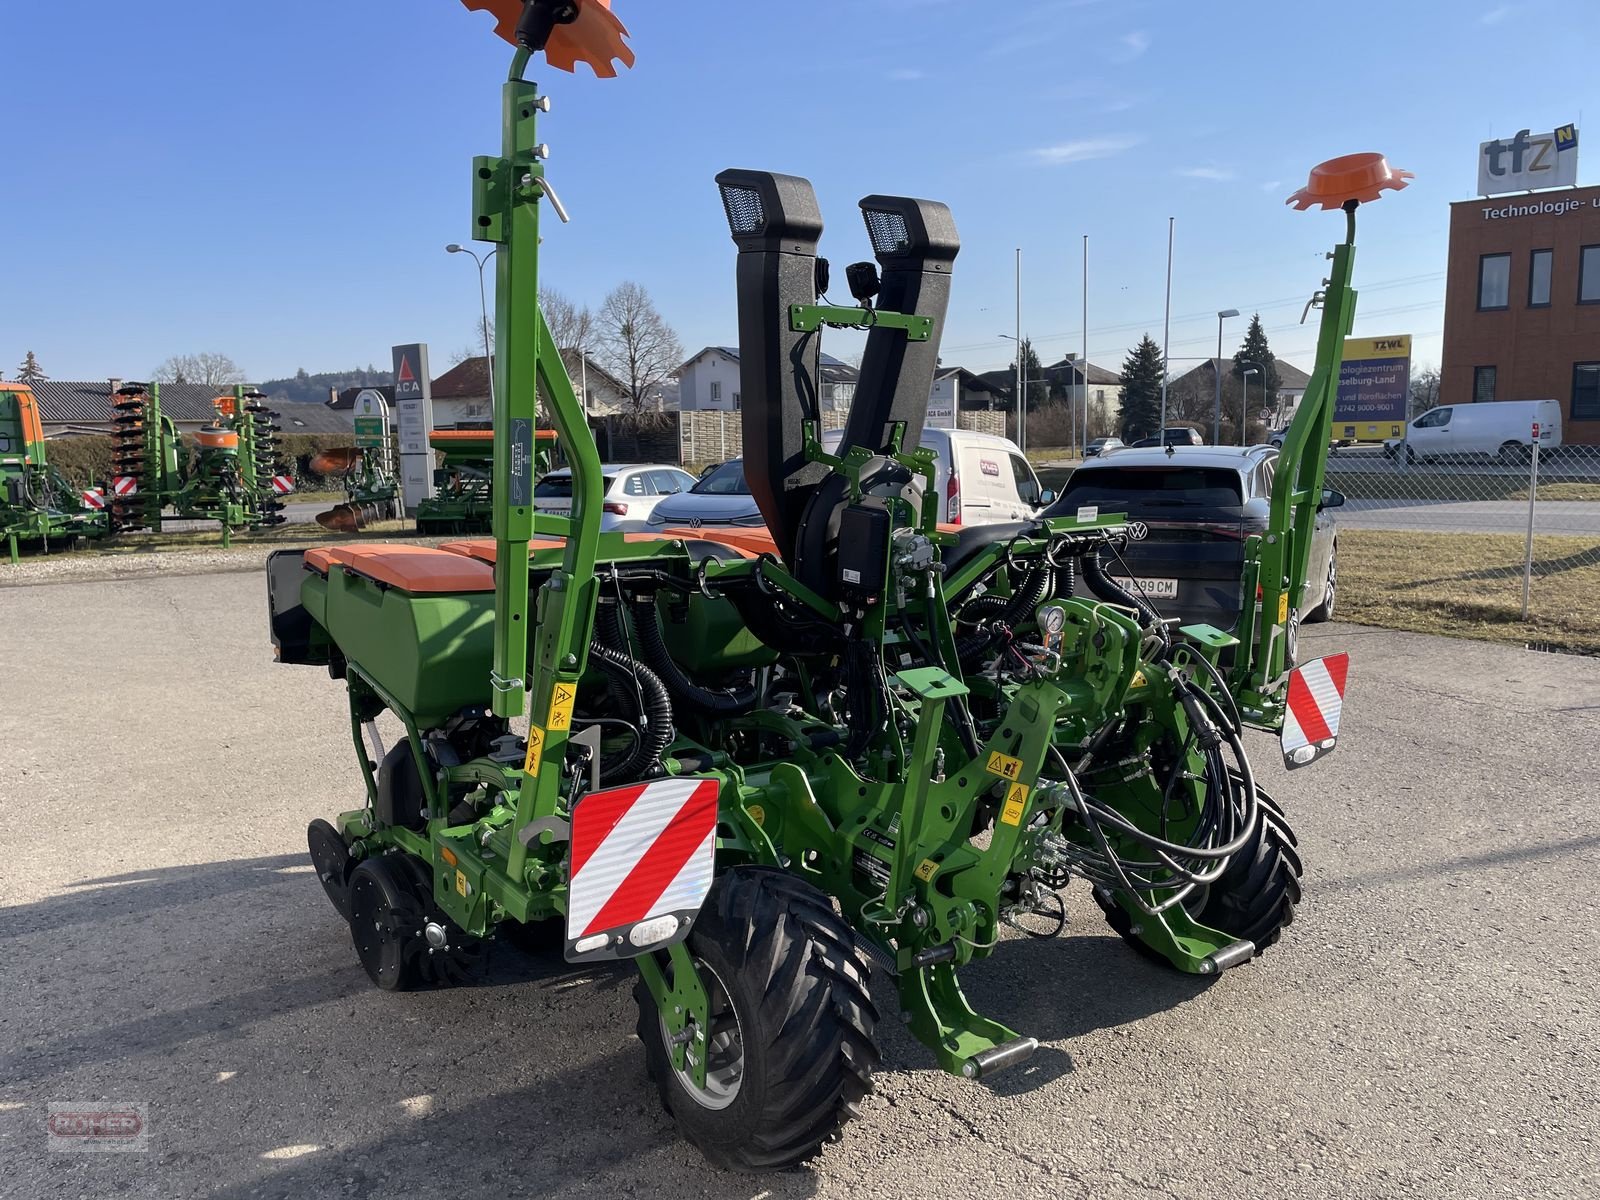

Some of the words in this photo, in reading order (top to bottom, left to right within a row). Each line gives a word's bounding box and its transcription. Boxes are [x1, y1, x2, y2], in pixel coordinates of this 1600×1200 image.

[1482, 199, 1585, 219] Technologie-
[1340, 364, 1404, 375] ologiezentrum
[396, 381, 420, 393] ACA
[1132, 580, 1155, 592] 999
[1157, 581, 1173, 593] CM
